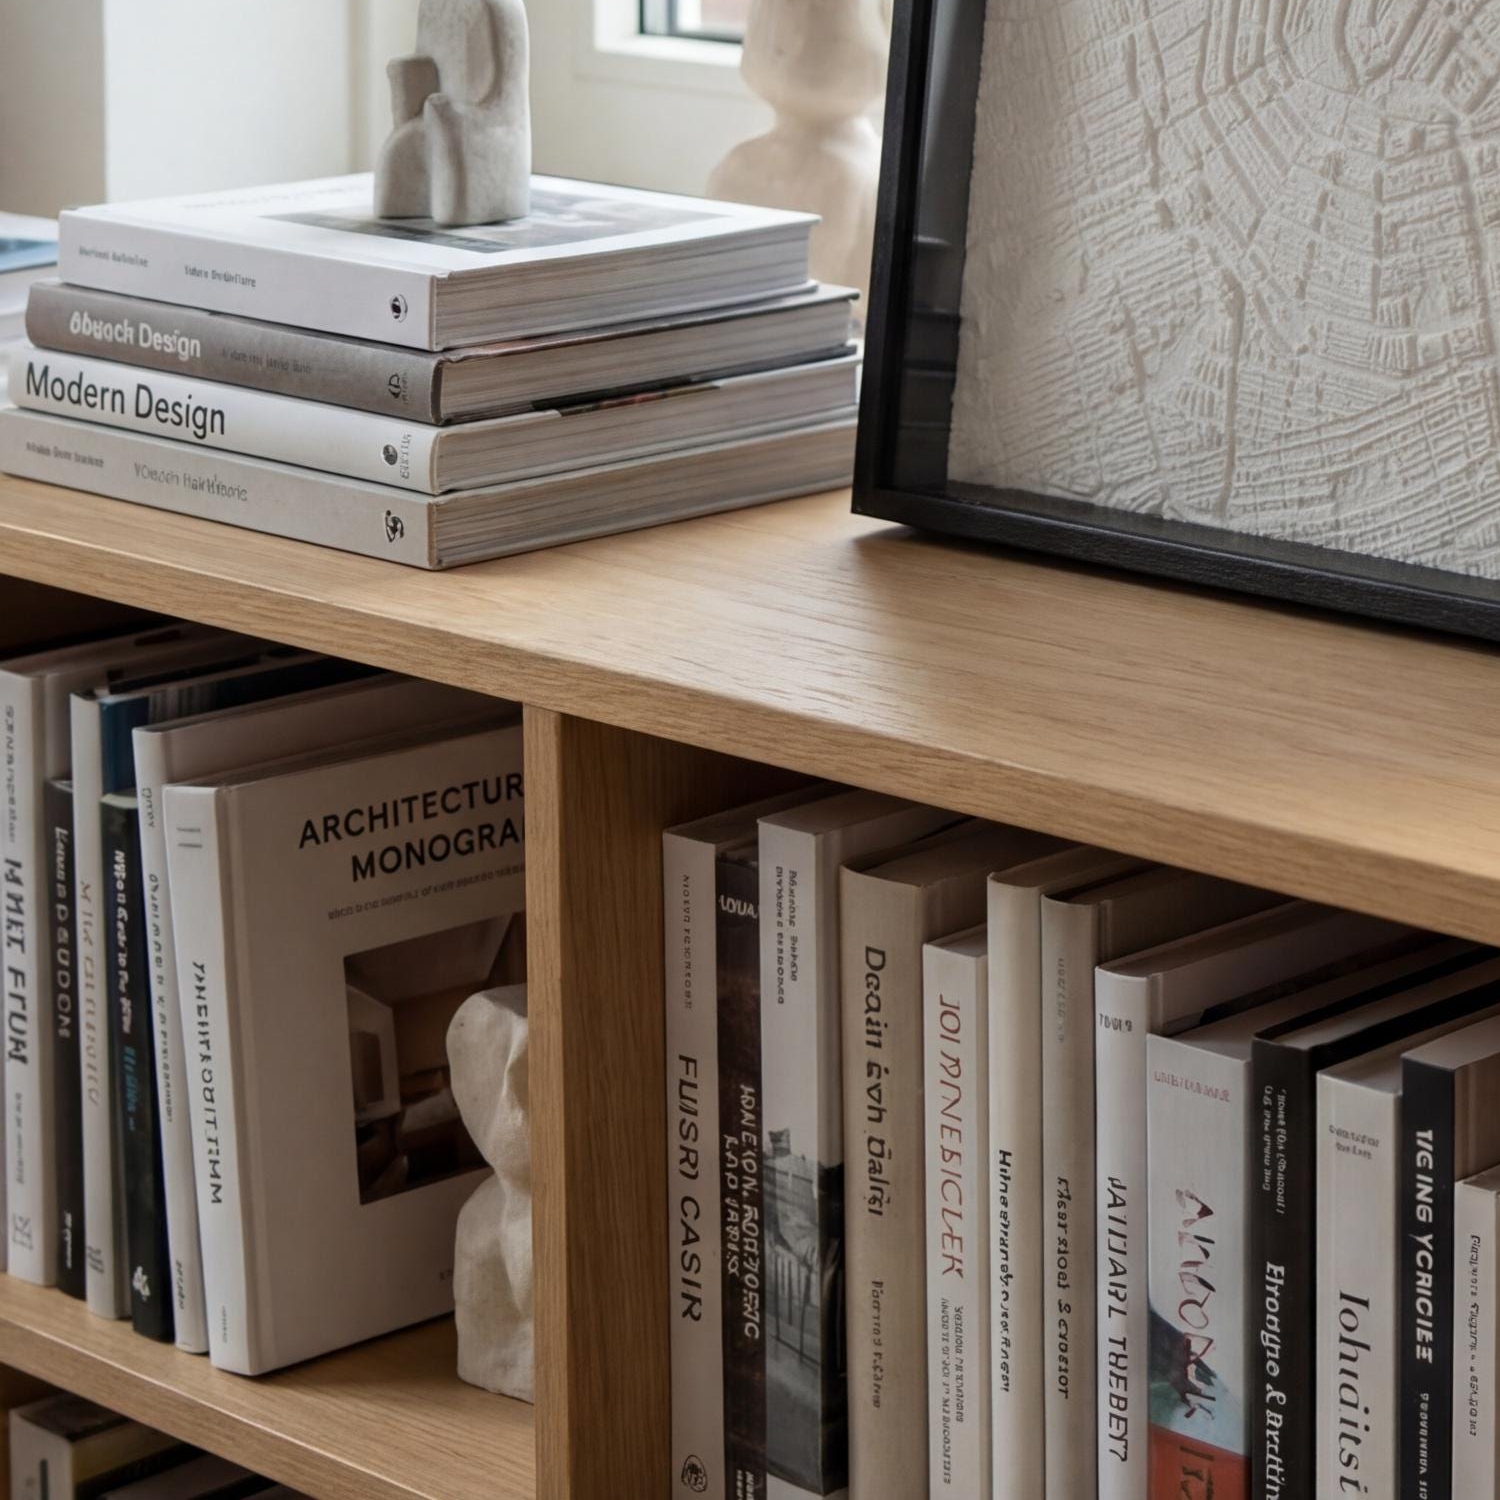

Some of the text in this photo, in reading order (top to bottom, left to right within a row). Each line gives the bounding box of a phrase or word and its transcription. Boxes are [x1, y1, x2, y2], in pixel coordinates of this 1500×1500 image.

[26, 361, 225, 440] Modern Design
[351, 815, 525, 883] MONOGRA
